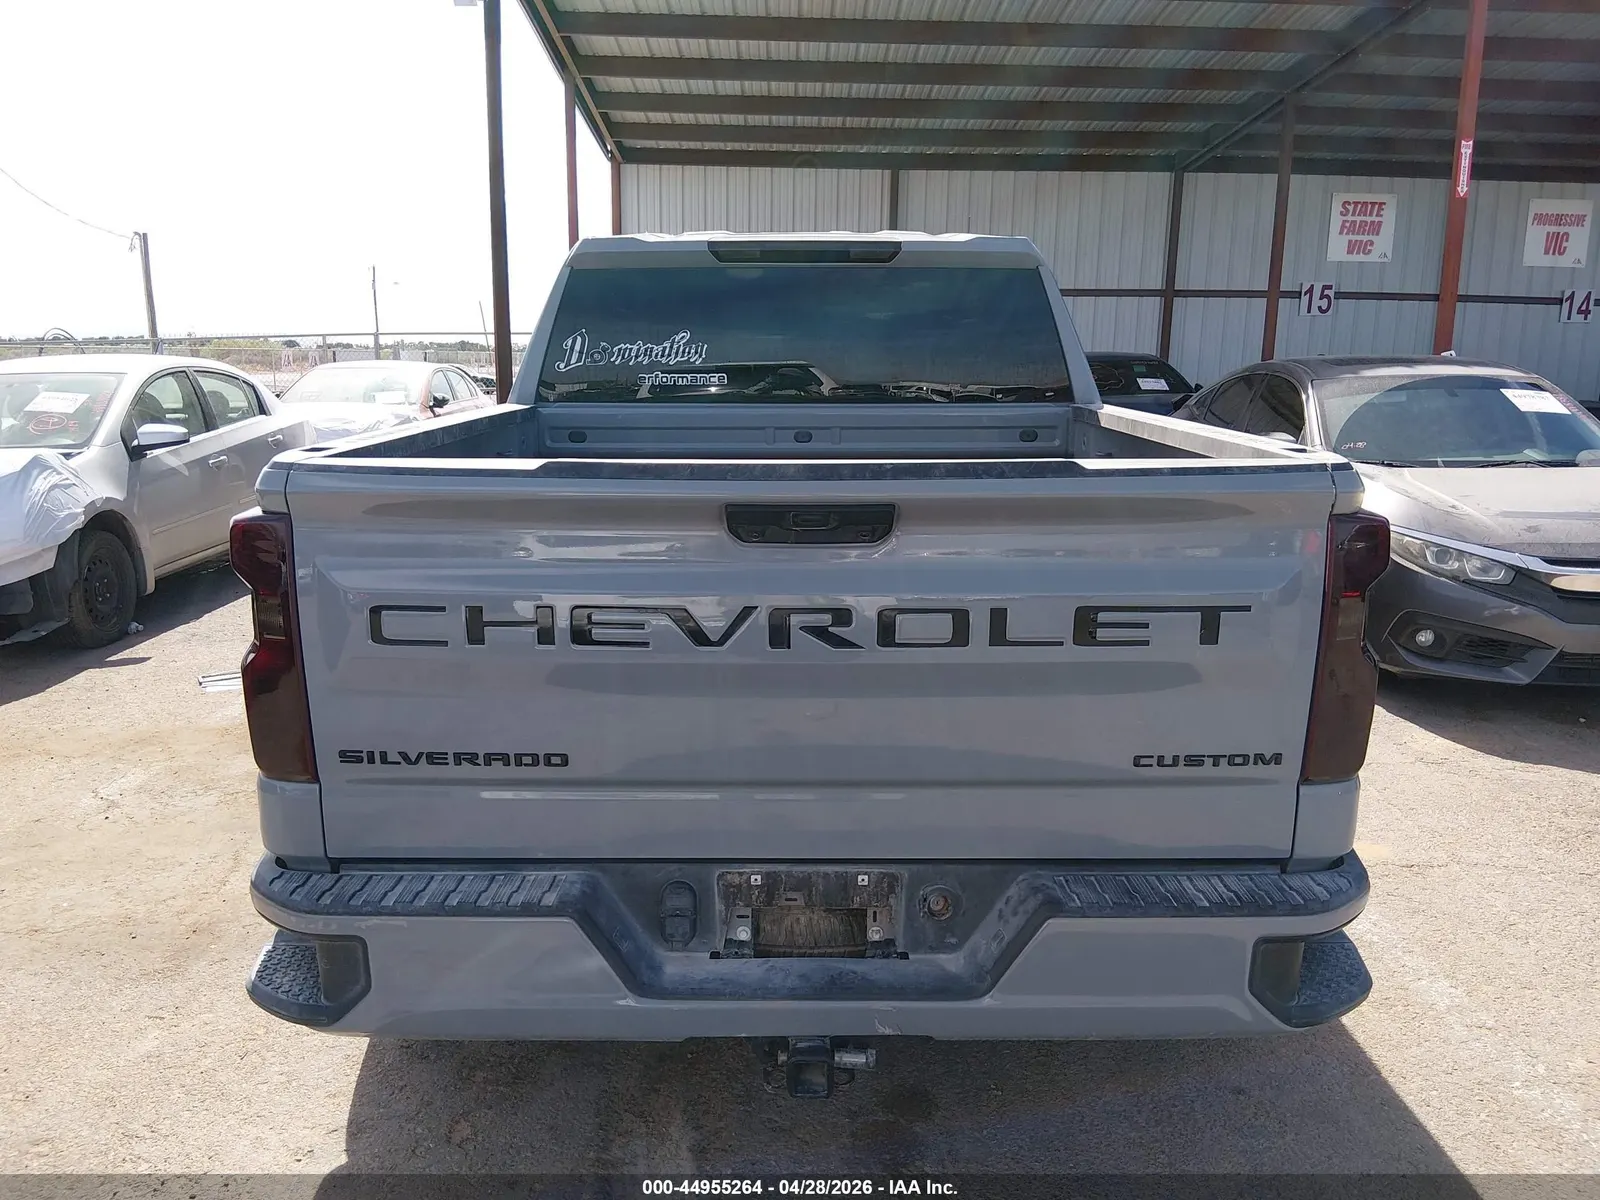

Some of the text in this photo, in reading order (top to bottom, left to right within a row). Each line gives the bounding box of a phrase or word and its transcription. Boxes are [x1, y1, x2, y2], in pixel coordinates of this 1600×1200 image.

[1340, 200, 1387, 217] STATE
[1338, 219, 1383, 236] FARM
[1531, 212, 1587, 228] PROGRESSIVE
[1346, 239, 1375, 255] VIC
[1543, 231, 1570, 256] VIC
[1303, 283, 1333, 314] 15
[1564, 290, 1592, 321] 14
[637, 371, 728, 385] erformance
[369, 604, 1252, 649] CHEVROLET
[338, 749, 569, 768] SILVERADO
[1132, 752, 1283, 768] CUSTOM
